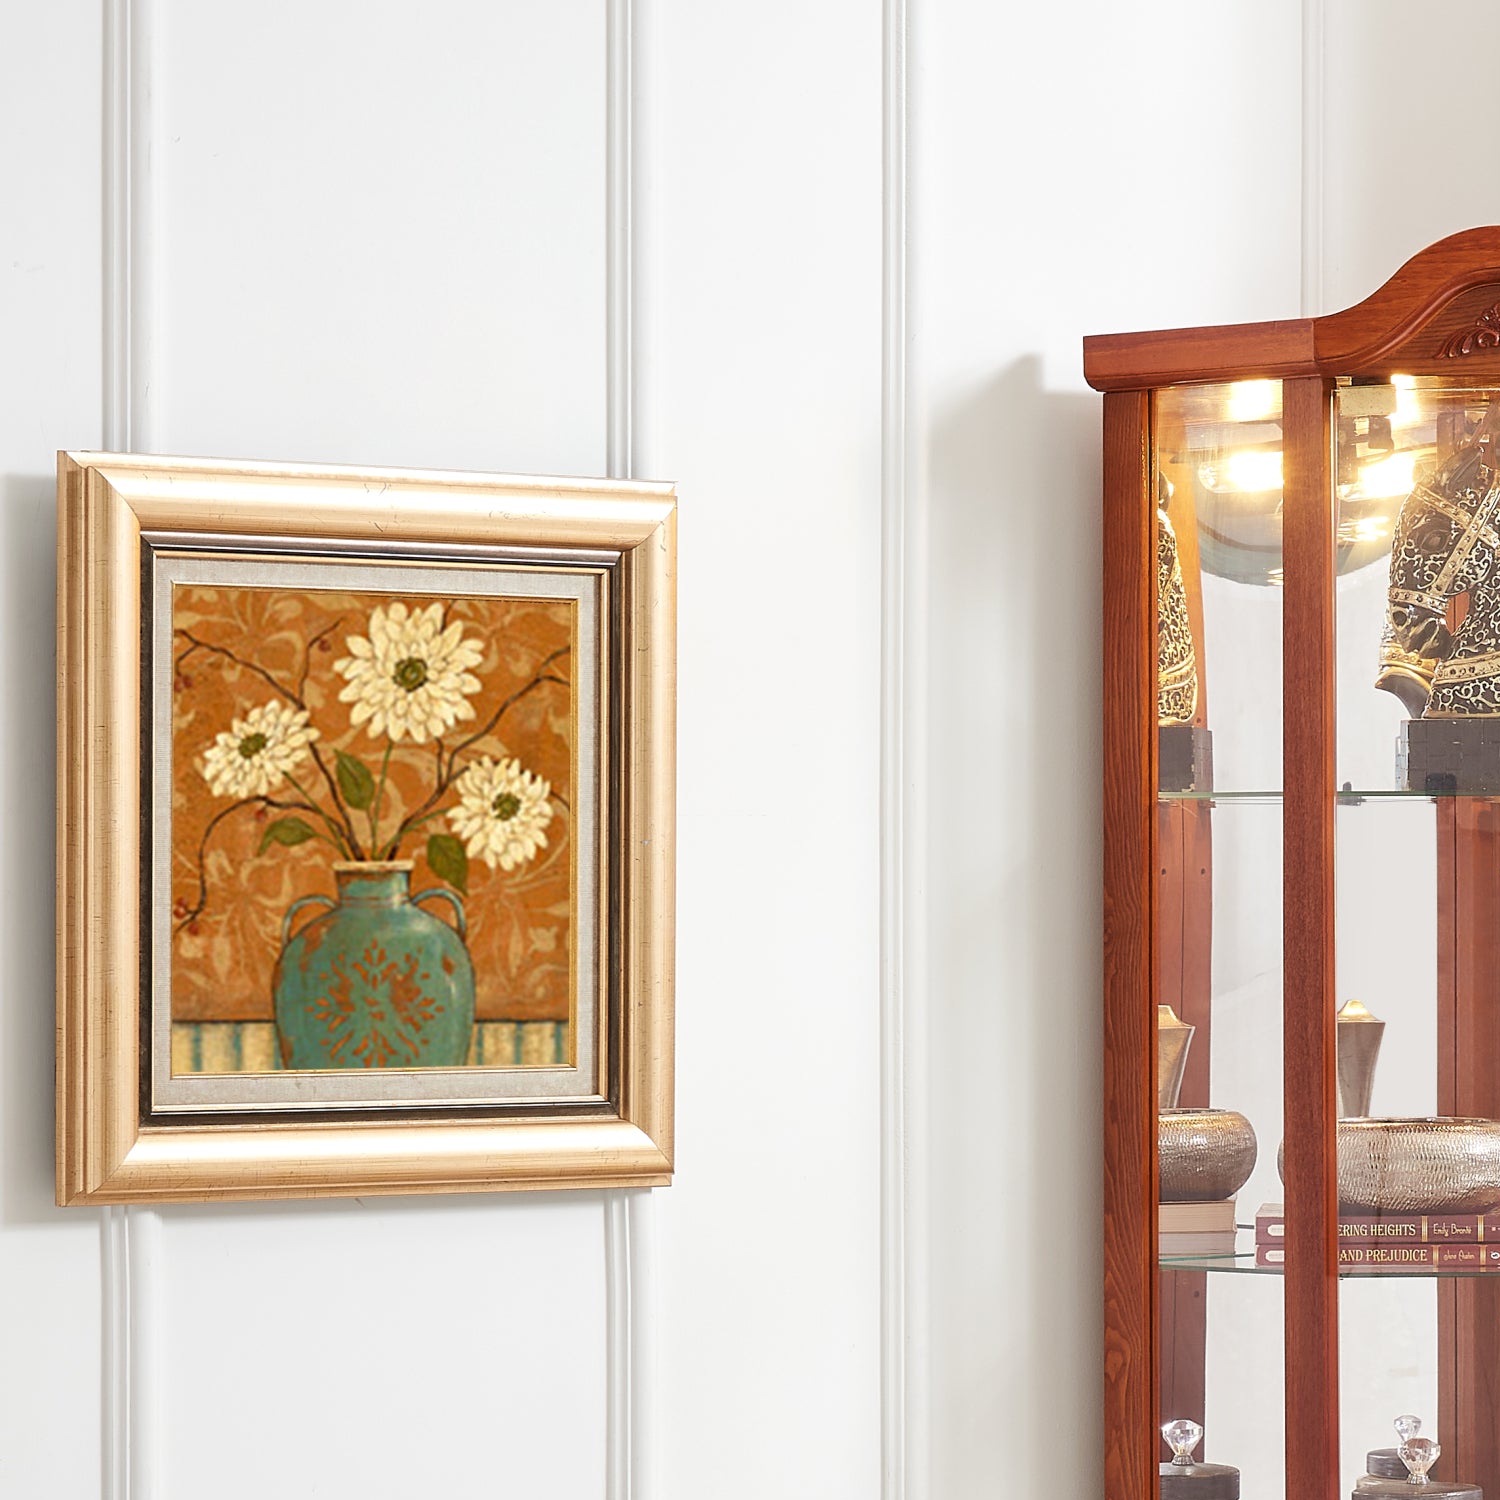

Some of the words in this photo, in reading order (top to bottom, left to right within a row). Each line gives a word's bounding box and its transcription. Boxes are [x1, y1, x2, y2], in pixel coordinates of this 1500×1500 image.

[1338, 1224, 1368, 1237] ERING
[1370, 1223, 1416, 1236] HEIGHTS
[1340, 1249, 1363, 1262] AND
[1366, 1249, 1428, 1262] PREJUDICE
